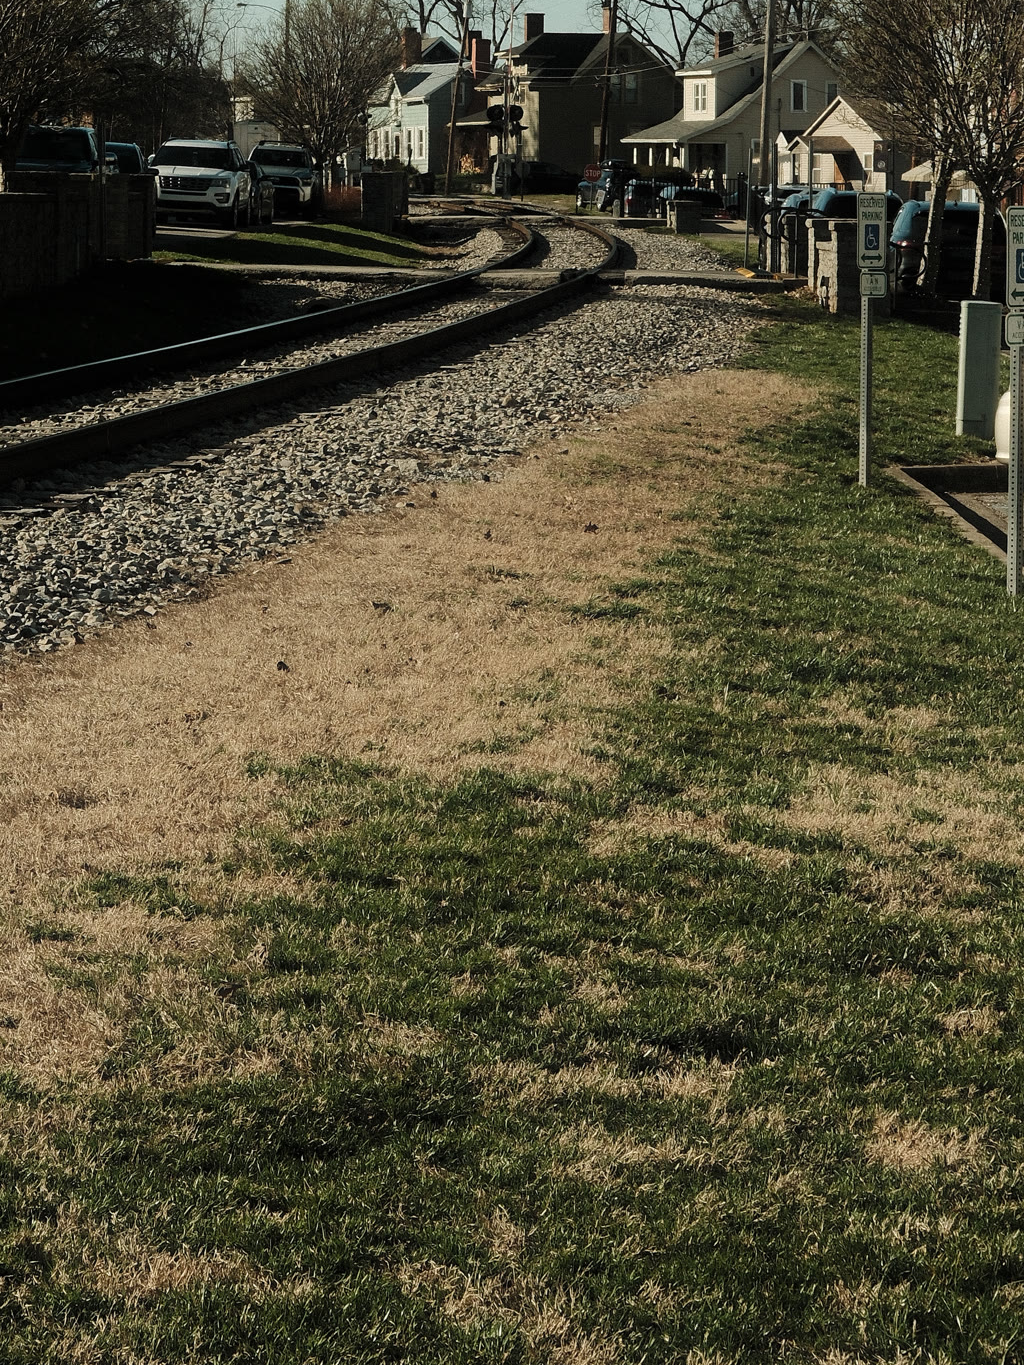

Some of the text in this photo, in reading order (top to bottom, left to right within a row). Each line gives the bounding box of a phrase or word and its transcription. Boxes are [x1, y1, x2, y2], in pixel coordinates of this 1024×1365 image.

[585, 169, 601, 177] STOP
[860, 198, 884, 208] RESERVED
[862, 211, 882, 221] PARKING
[866, 277, 879, 285] VAN
